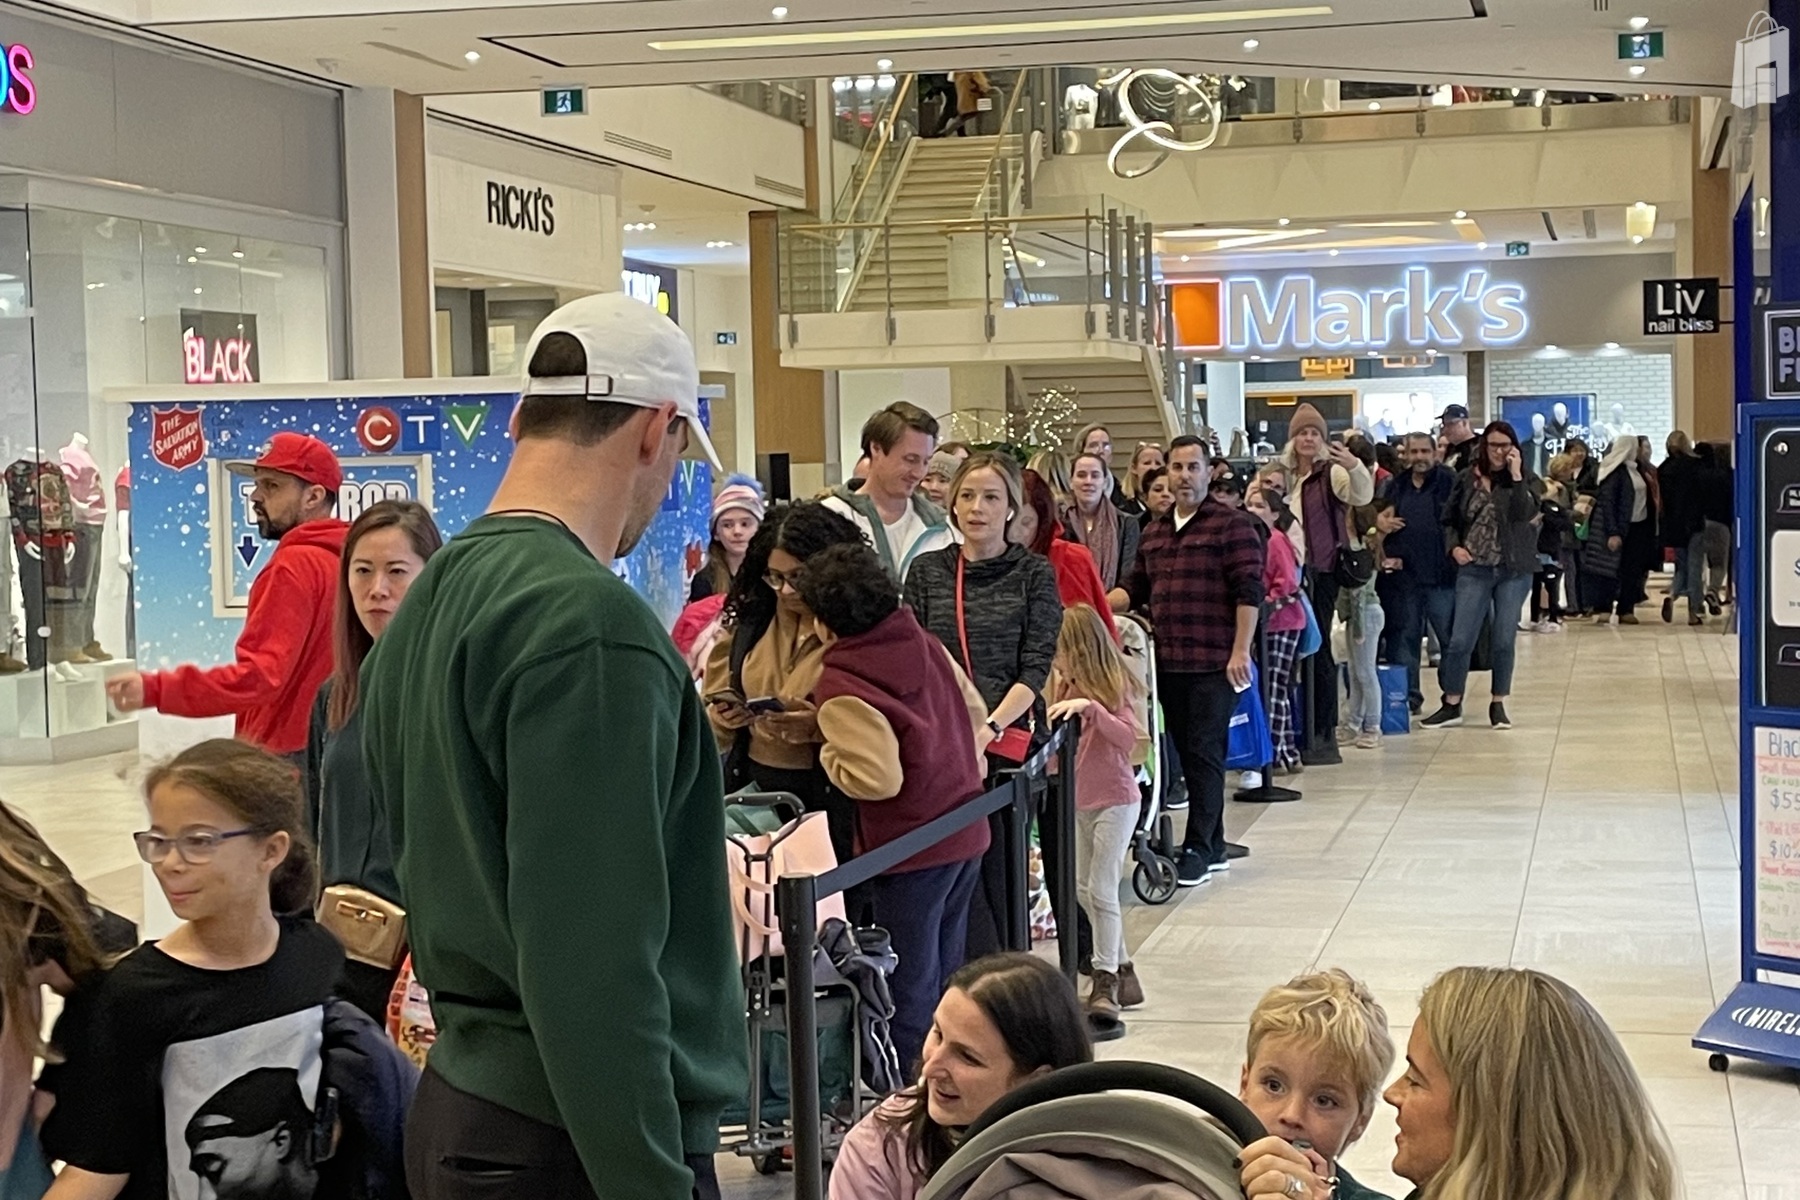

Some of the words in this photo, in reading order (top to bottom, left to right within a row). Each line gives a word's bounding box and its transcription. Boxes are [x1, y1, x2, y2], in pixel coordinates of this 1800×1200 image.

[487, 181, 555, 237] RICKI'S
[1226, 265, 1528, 349] Mark's
[1648, 317, 1676, 333] nail
[1679, 317, 1715, 332] bliss
[185, 336, 253, 383] BLACK
[155, 420, 199, 456] SALVATION
[161, 414, 182, 435] THE
[171, 435, 199, 464] ARMY
